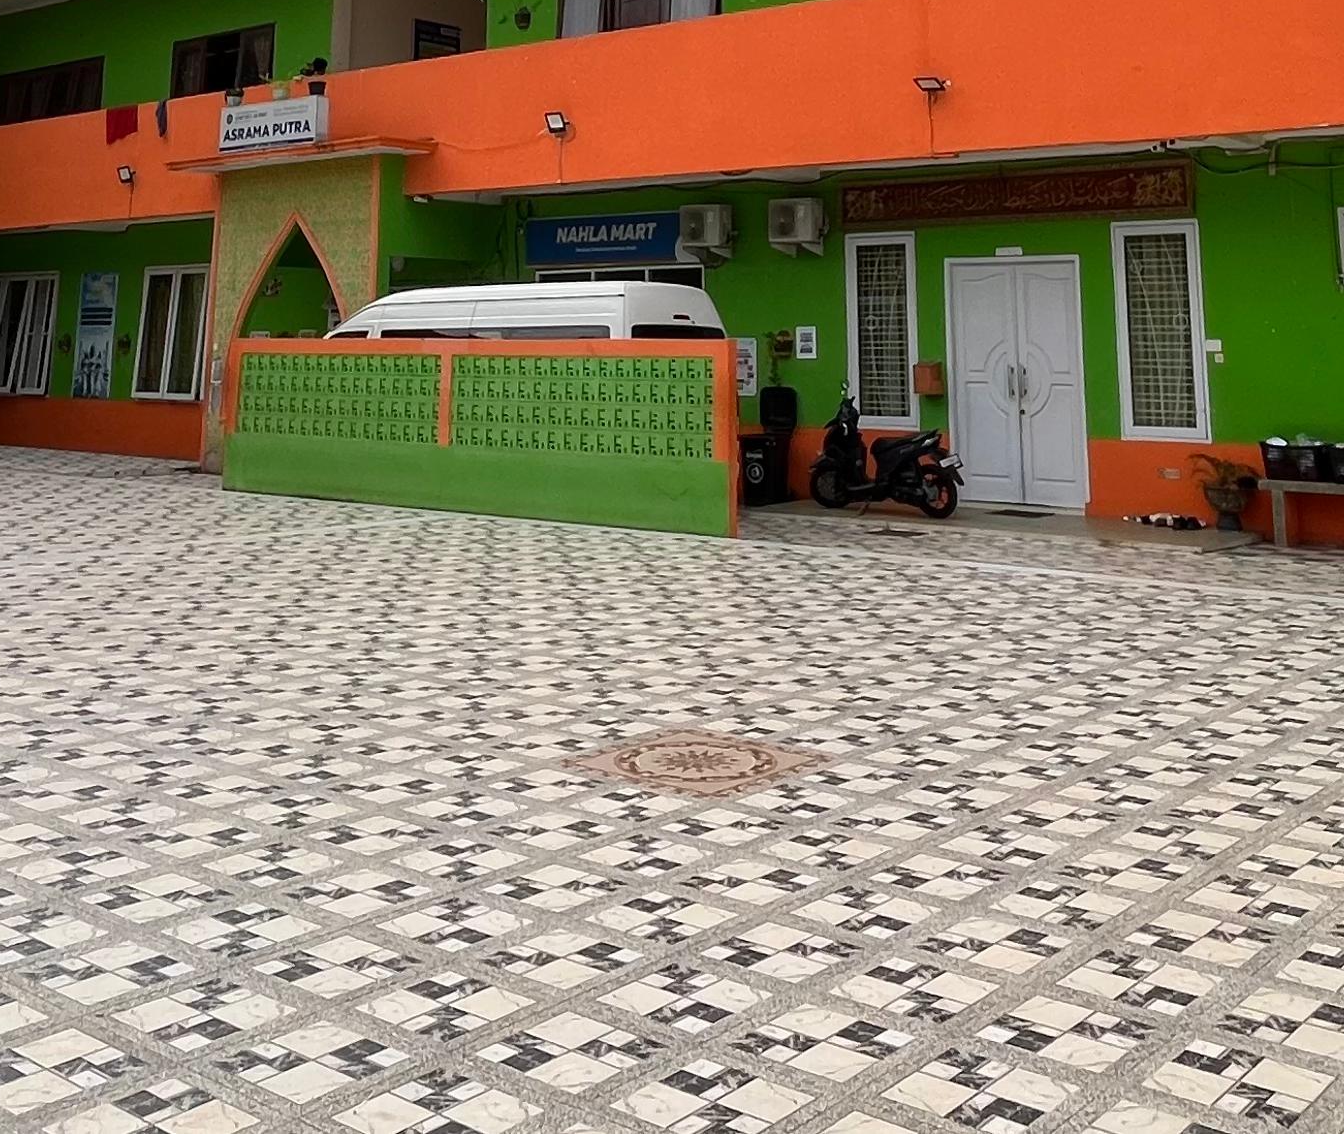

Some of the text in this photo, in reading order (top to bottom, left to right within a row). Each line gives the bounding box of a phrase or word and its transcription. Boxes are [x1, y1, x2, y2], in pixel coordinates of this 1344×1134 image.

[223, 119, 311, 142] ASRAMA PUTRA
[556, 222, 657, 243] NAHLA MART
